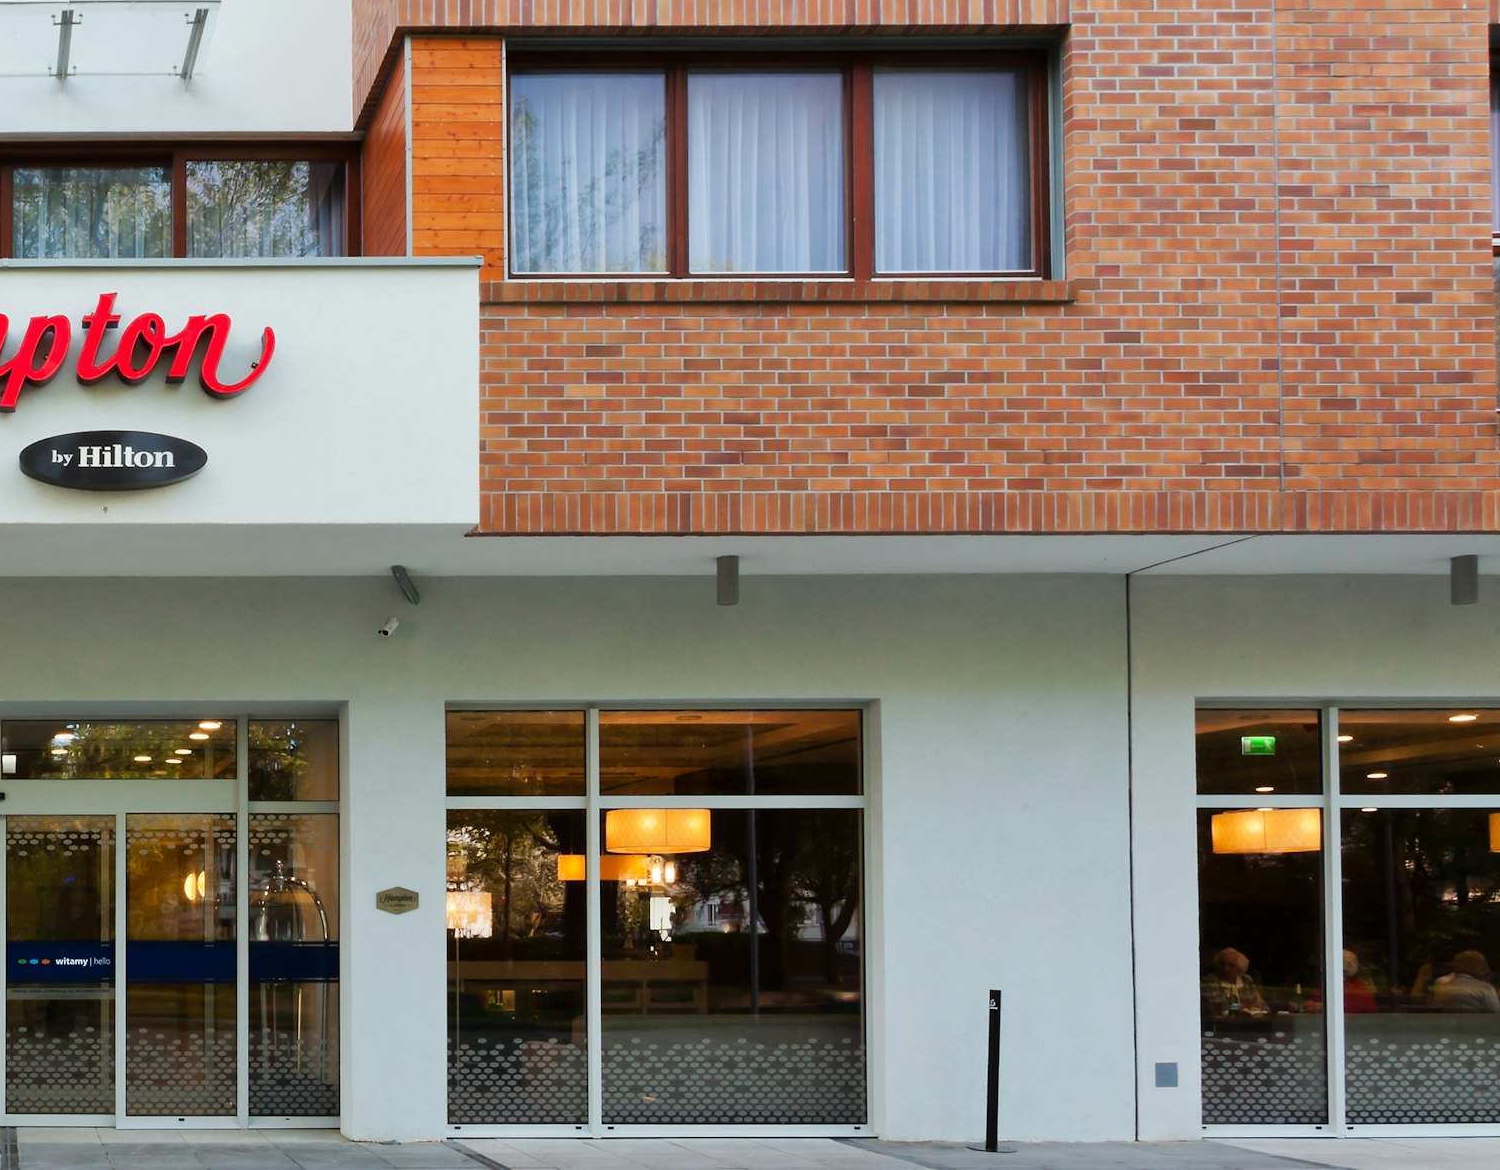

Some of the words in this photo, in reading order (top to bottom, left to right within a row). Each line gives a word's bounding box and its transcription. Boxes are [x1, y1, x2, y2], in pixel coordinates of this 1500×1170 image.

[51, 449, 74, 467] by
[77, 443, 176, 468] Hilton
[55, 956, 88, 967] witamy
[93, 957, 111, 966] hello
